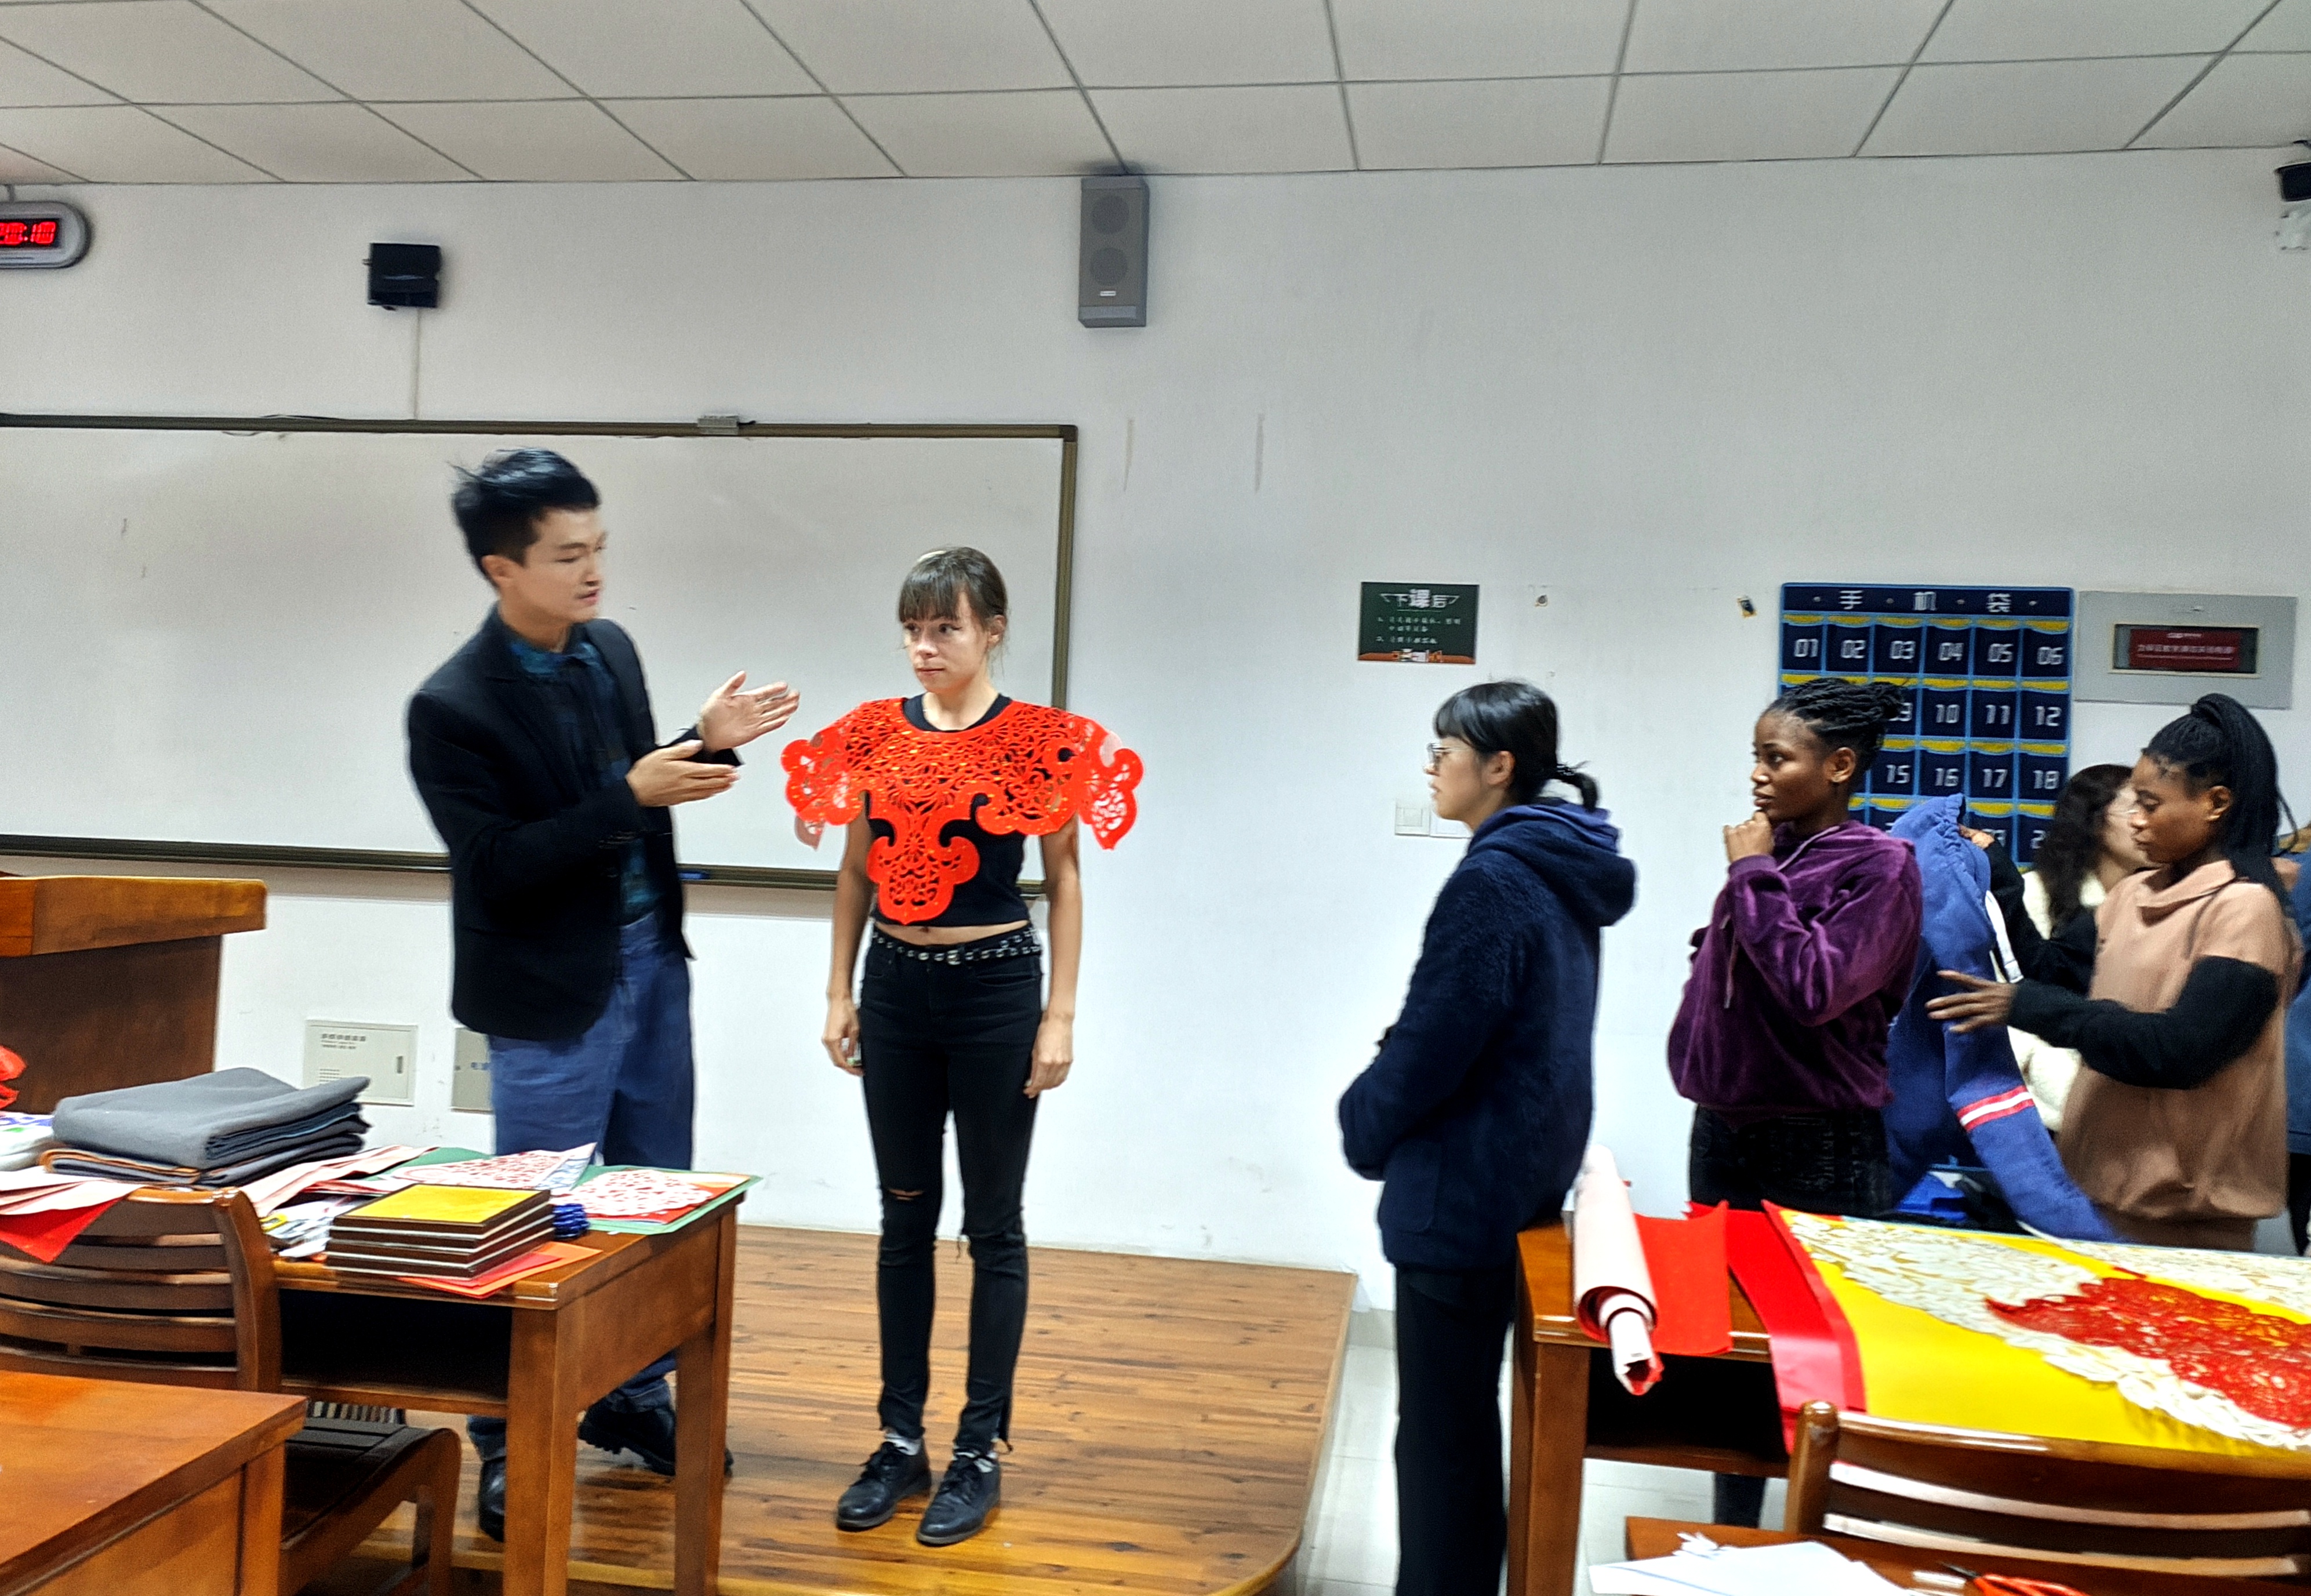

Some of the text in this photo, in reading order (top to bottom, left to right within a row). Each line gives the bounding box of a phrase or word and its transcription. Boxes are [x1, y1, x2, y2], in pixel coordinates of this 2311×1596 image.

[1794, 638, 2063, 665] 01 02 03 04 05 06
[1935, 704, 1960, 724] 10
[1985, 704, 2011, 724] 11
[2034, 706, 2062, 726] 12
[1886, 765, 2059, 789] 15 16 17 18
